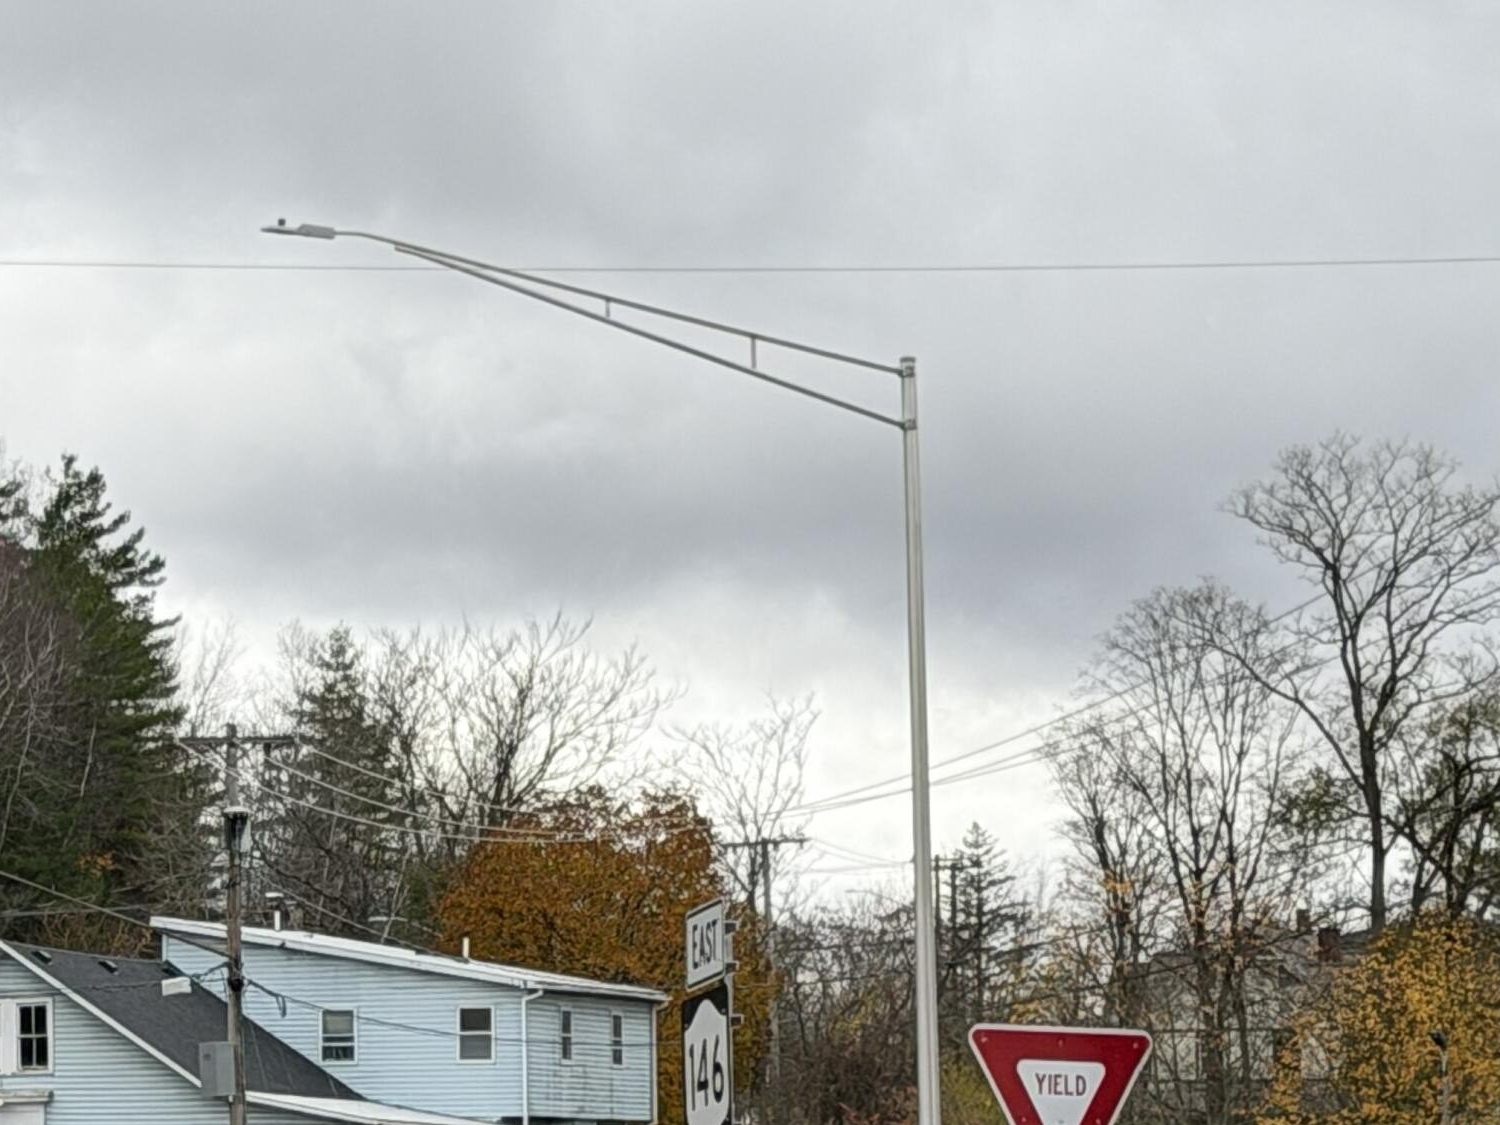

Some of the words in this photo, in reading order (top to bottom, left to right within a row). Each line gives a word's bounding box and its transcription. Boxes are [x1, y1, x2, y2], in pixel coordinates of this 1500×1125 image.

[691, 918, 719, 970] EAST
[689, 1034, 725, 1112] 146
[1034, 1072, 1087, 1097] YIELD
